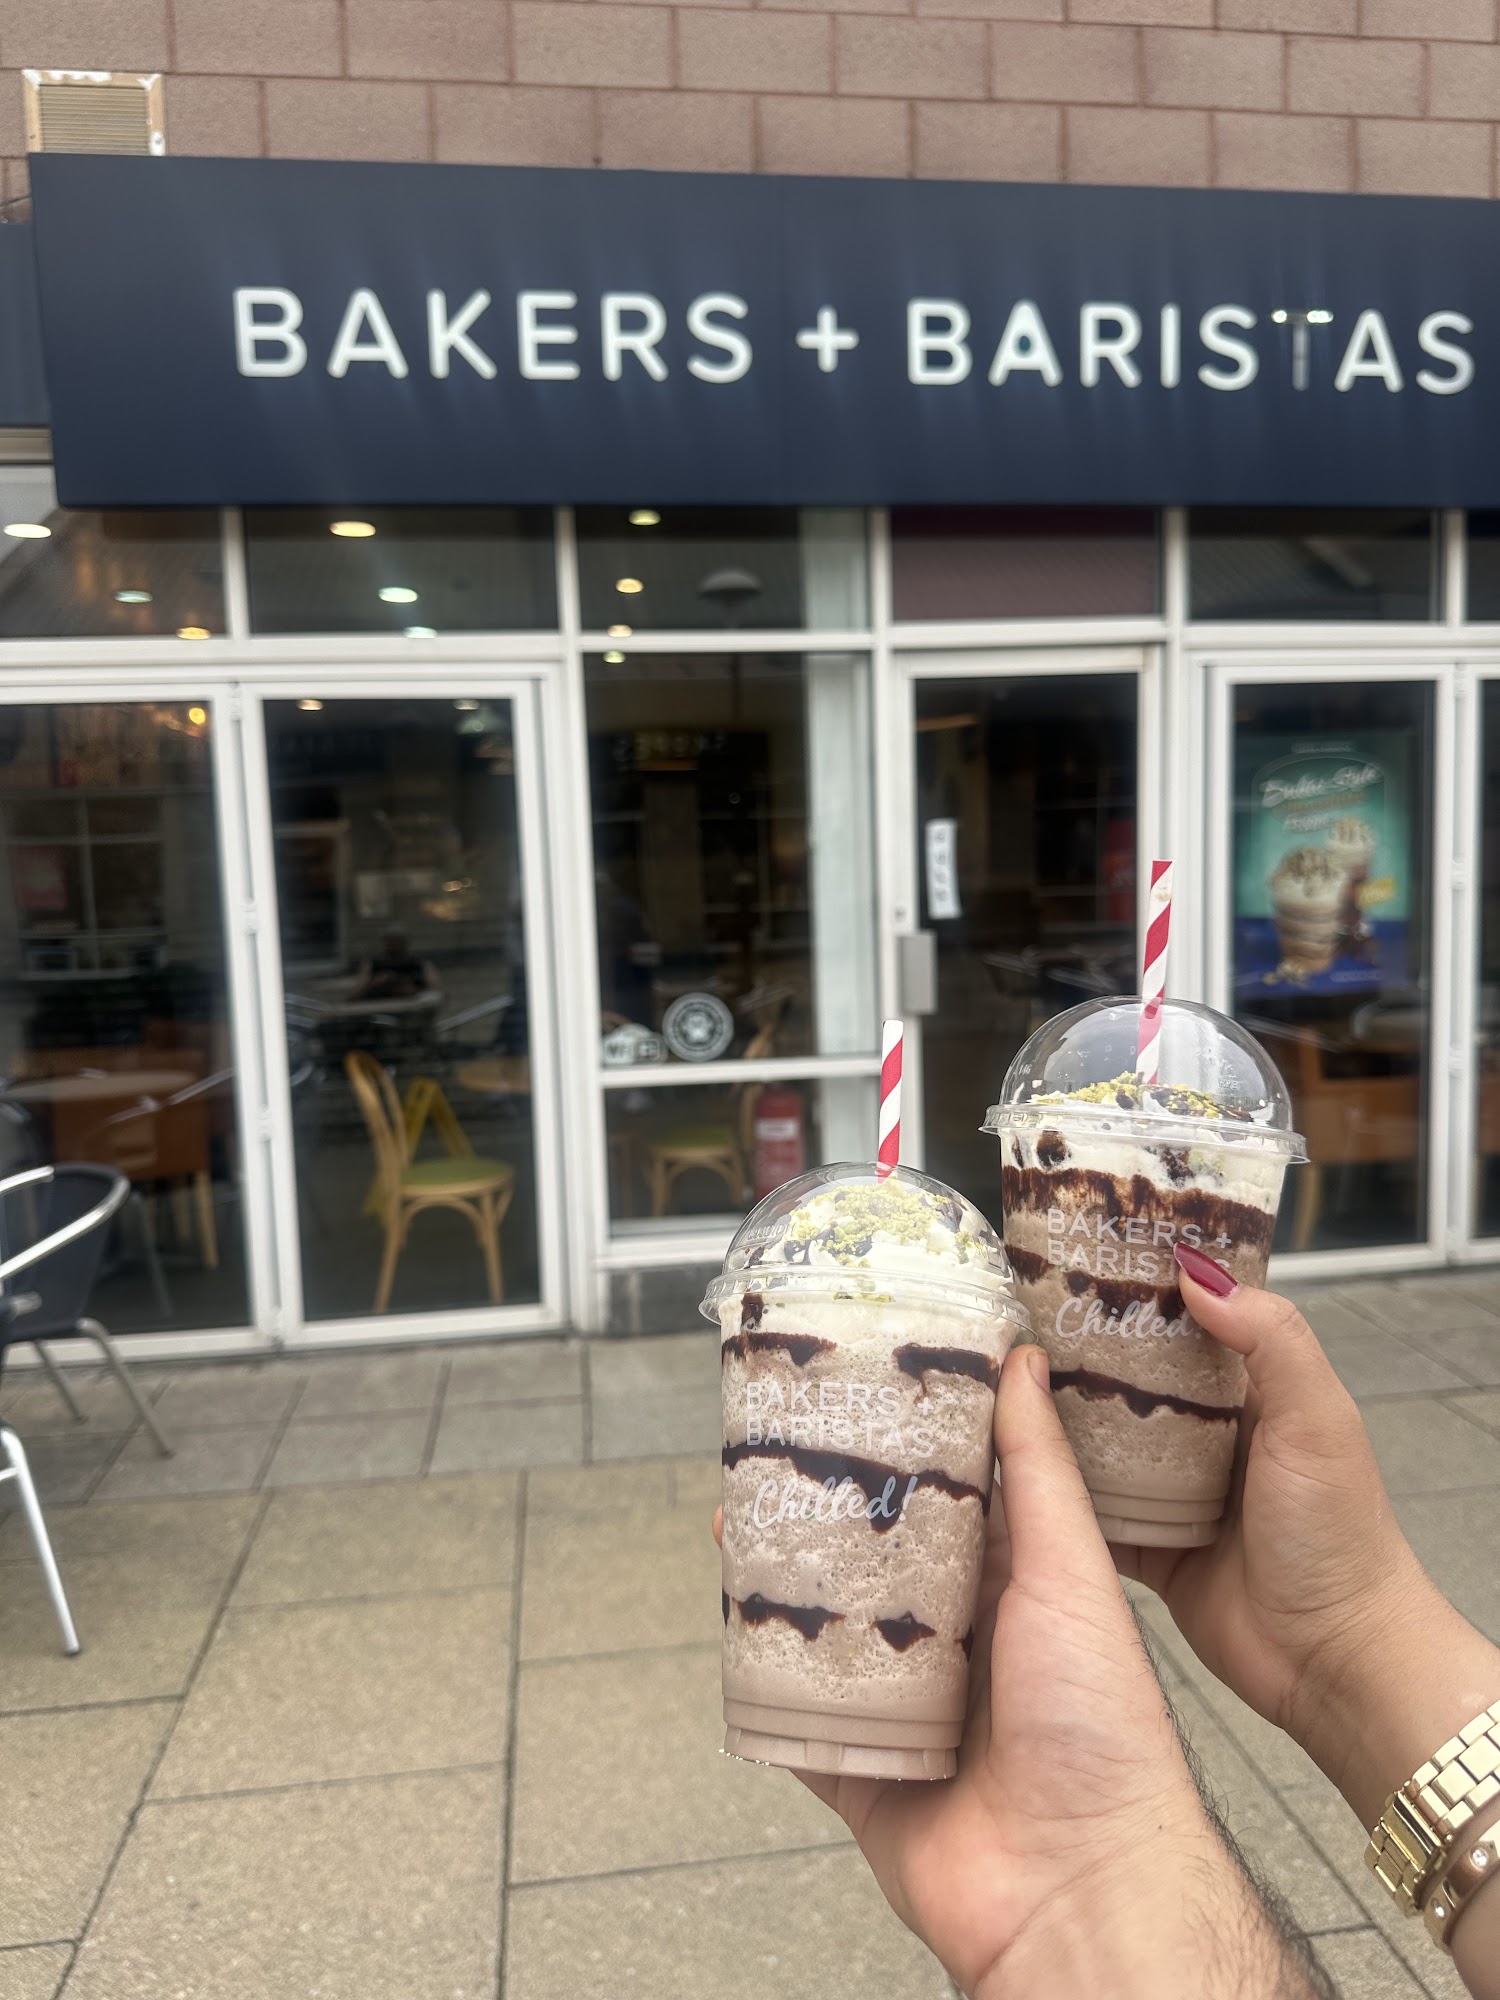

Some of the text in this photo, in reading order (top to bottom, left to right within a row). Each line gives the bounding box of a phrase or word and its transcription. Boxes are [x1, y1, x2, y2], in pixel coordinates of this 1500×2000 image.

[233, 287, 1475, 395] BAKERS + BARISTAS
[1047, 1208, 1232, 1250] BAKERS +
[1047, 1239, 1230, 1280] BARIST
[1056, 1297, 1201, 1339] Chilled
[746, 1380, 935, 1417] BAKERS +
[746, 1416, 935, 1459] BARISTAS
[753, 1475, 919, 1529] Chilled!
